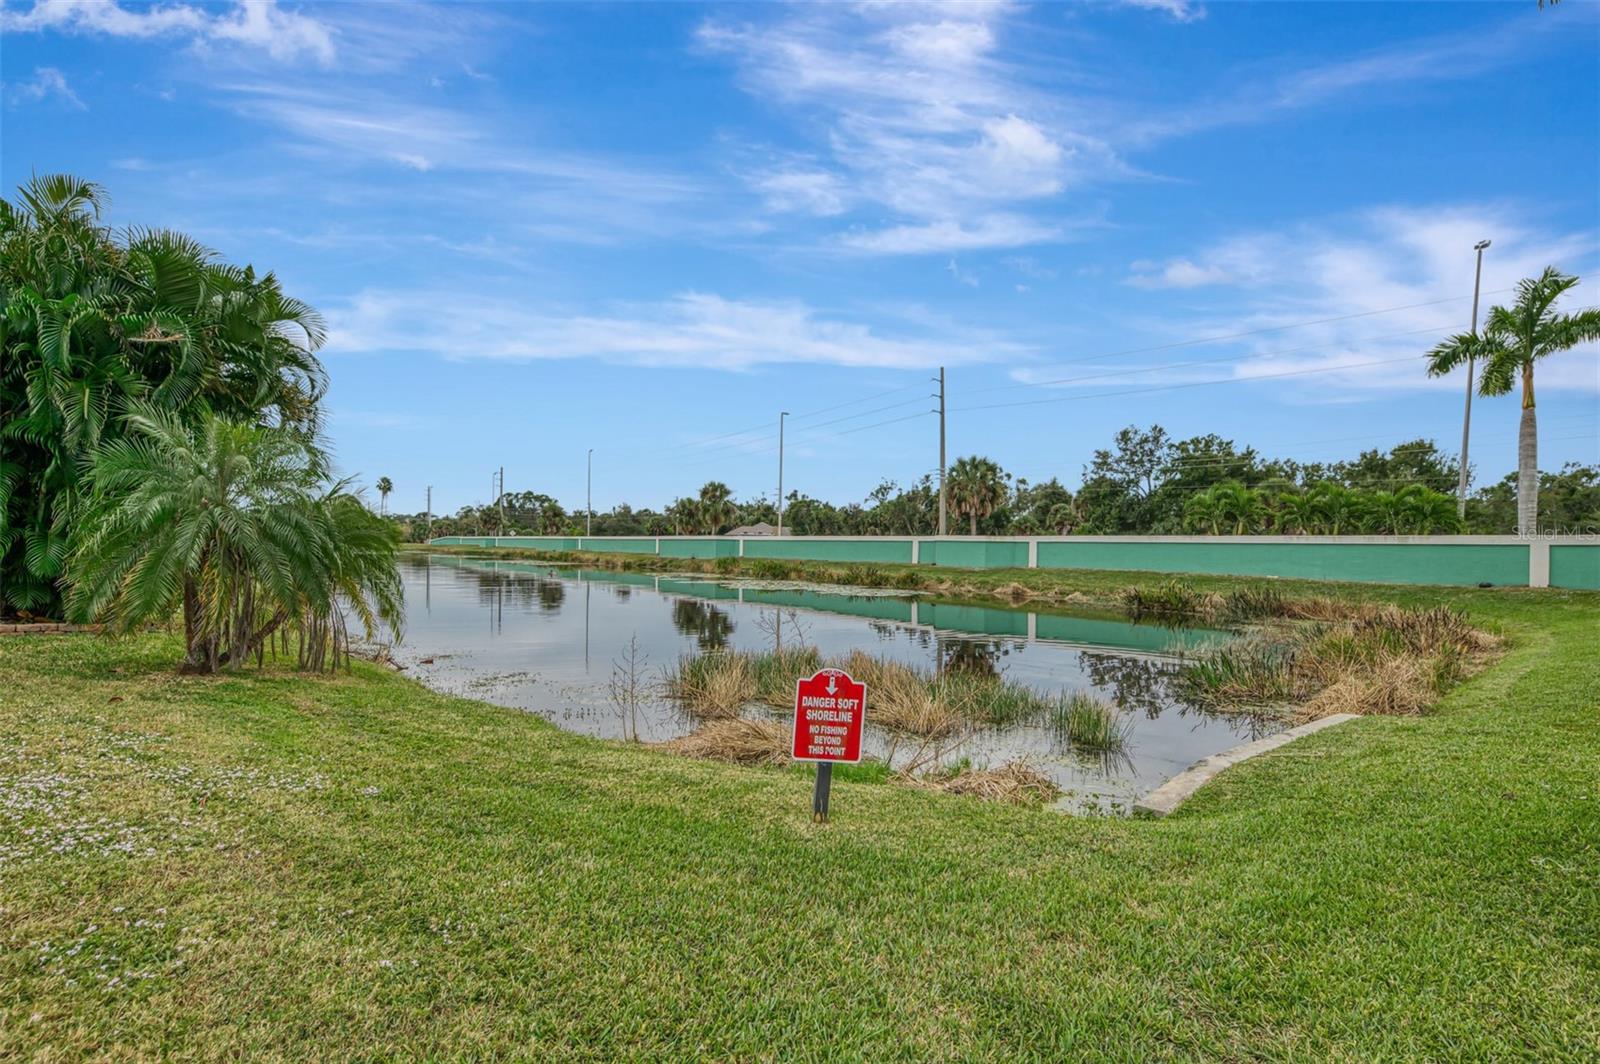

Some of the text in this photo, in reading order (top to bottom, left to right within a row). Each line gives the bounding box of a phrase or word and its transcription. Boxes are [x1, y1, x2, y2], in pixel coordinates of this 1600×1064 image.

[802, 696, 859, 710] DANGER SOFT
[806, 709, 853, 722] SHORELINE
[809, 725, 847, 735] NO FISHING
[814, 736, 841, 745] BEYOND
[808, 746, 846, 756] THIS POINT
